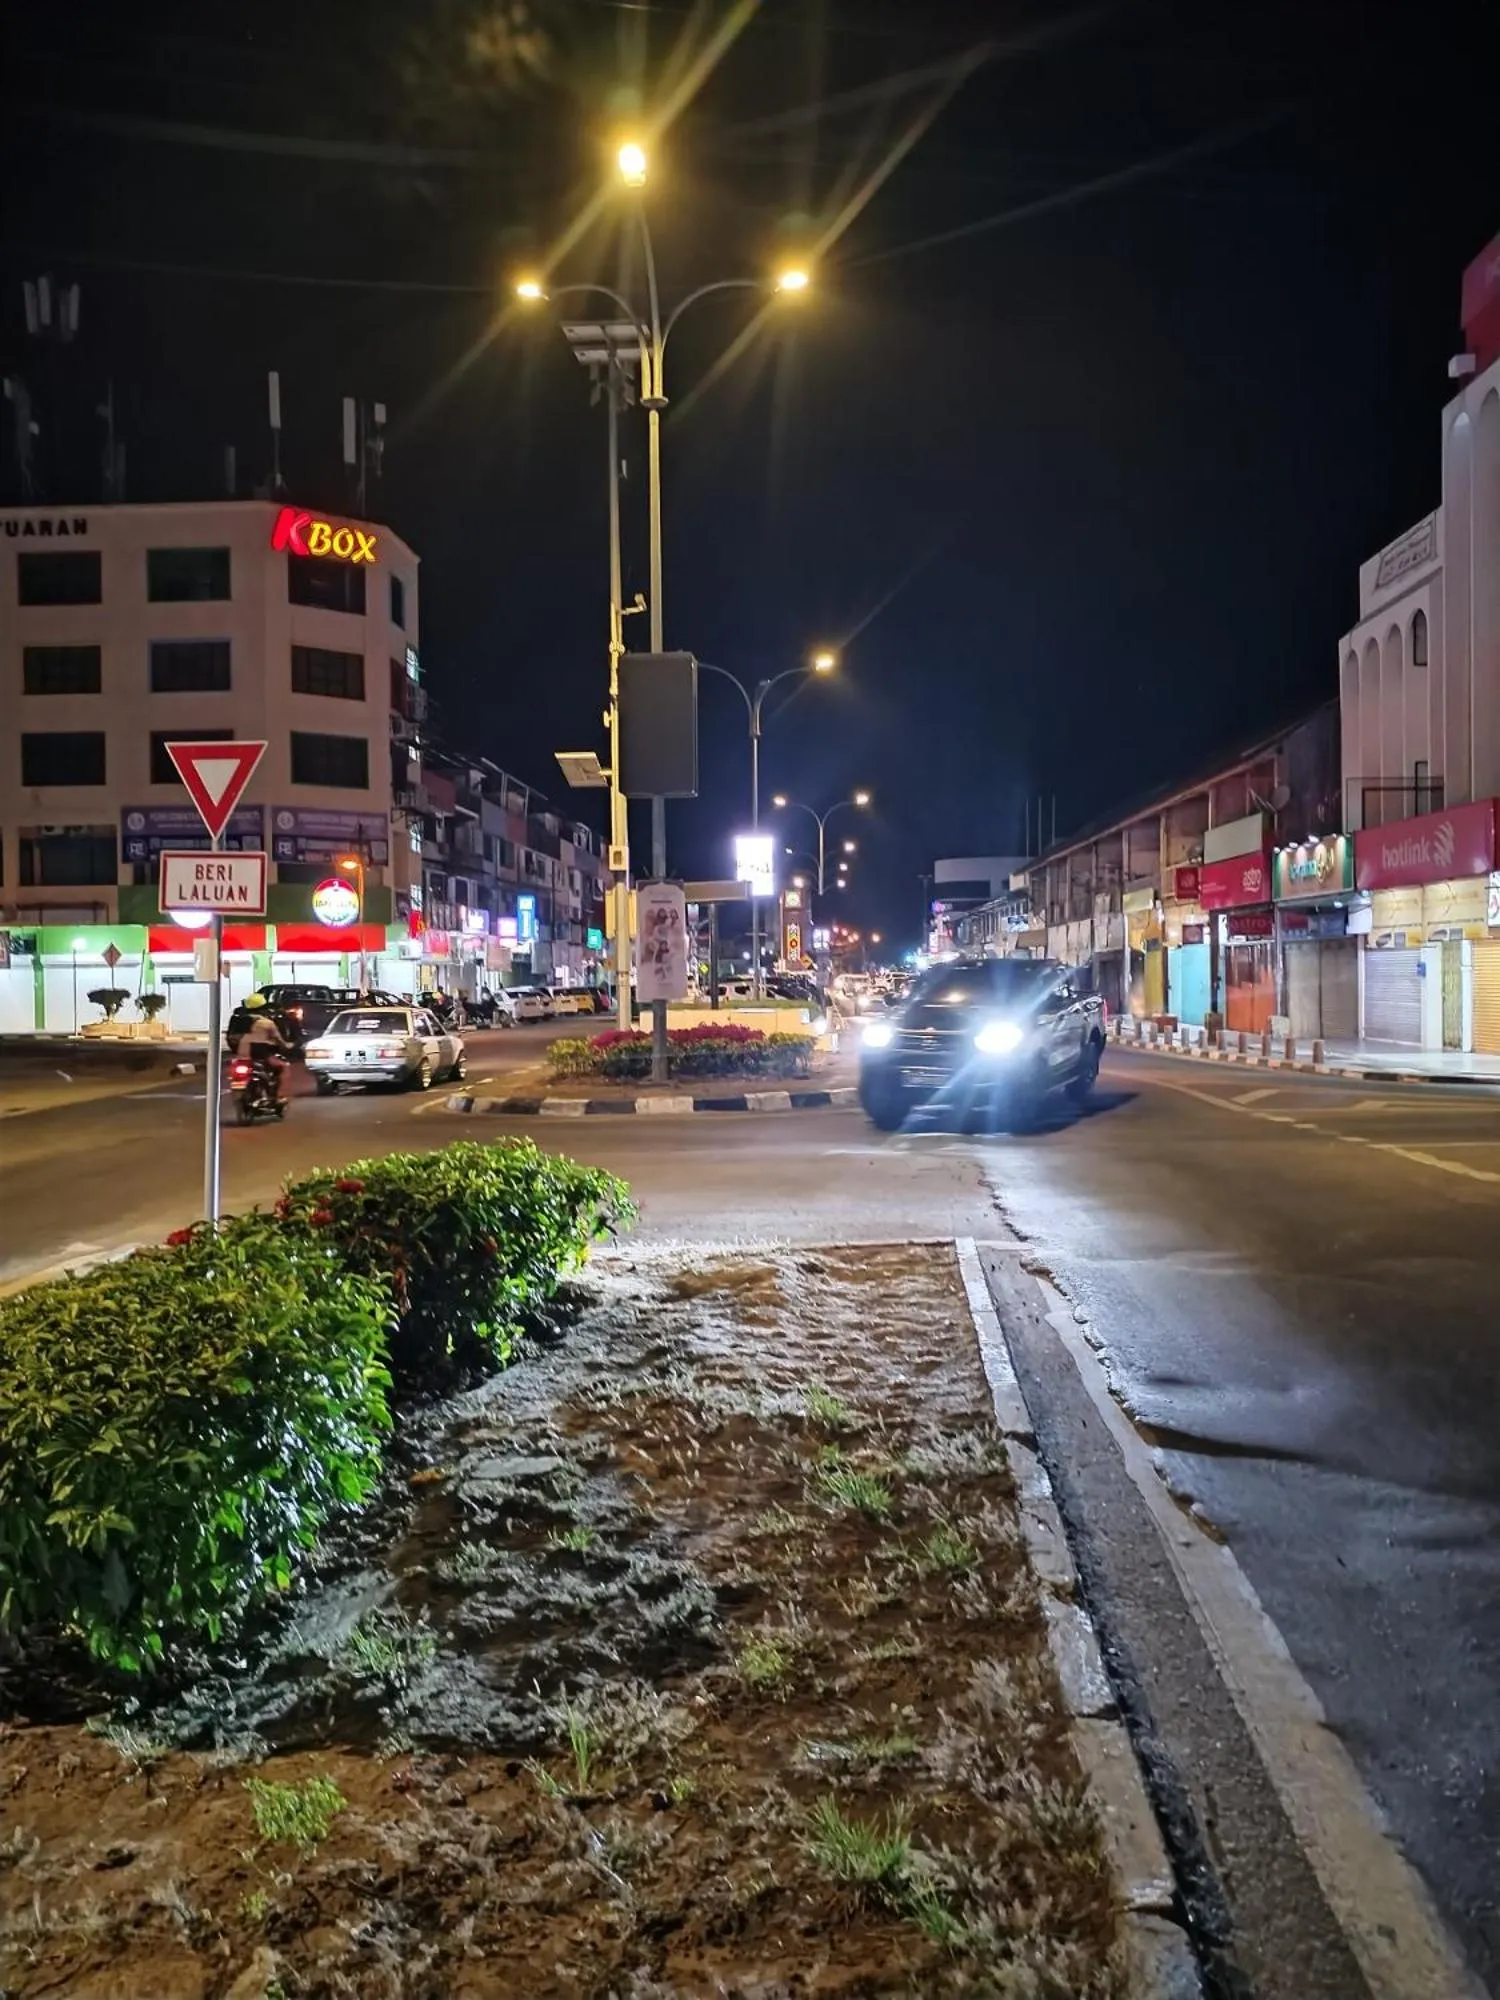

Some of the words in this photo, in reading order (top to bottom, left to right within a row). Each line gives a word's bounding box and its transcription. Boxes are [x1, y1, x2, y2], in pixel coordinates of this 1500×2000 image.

[0, 518, 88, 538] UARAN
[1382, 836, 1431, 871] hotlink
[195, 863, 233, 881] BERI
[179, 883, 248, 902] LALUAN
